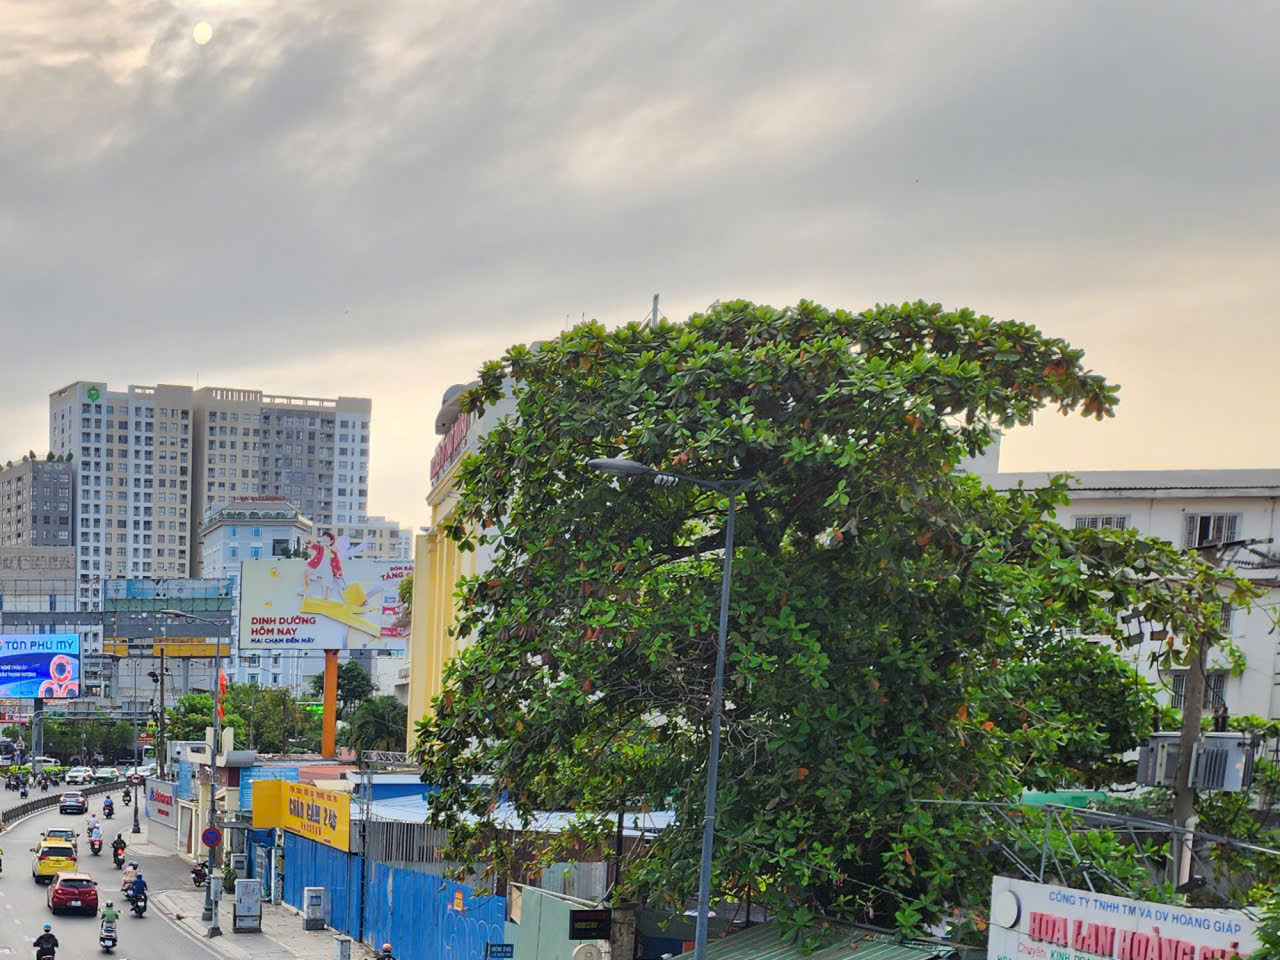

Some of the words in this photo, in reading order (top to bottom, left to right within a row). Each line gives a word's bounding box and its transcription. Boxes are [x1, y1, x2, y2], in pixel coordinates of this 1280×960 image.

[251, 616, 276, 625] DINH
[278, 614, 317, 625] DƯỠNG
[250, 625, 275, 636] HÔM
[276, 627, 298, 636] NAY
[264, 637, 284, 645] CHẠM
[285, 636, 300, 644] ĐẾN
[1048, 889, 1076, 905] CÔNG
[1078, 896, 1091, 908] TY
[1093, 898, 1120, 913] TNHH
[1121, 904, 1137, 916] TM
[1139, 905, 1153, 919] VÀ
[1155, 910, 1169, 921] DV
[1171, 912, 1210, 930] HOÀNG
[1213, 920, 1241, 934] GIÁP
[1028, 911, 1068, 947] HOA
[1071, 919, 1116, 958] LAN
